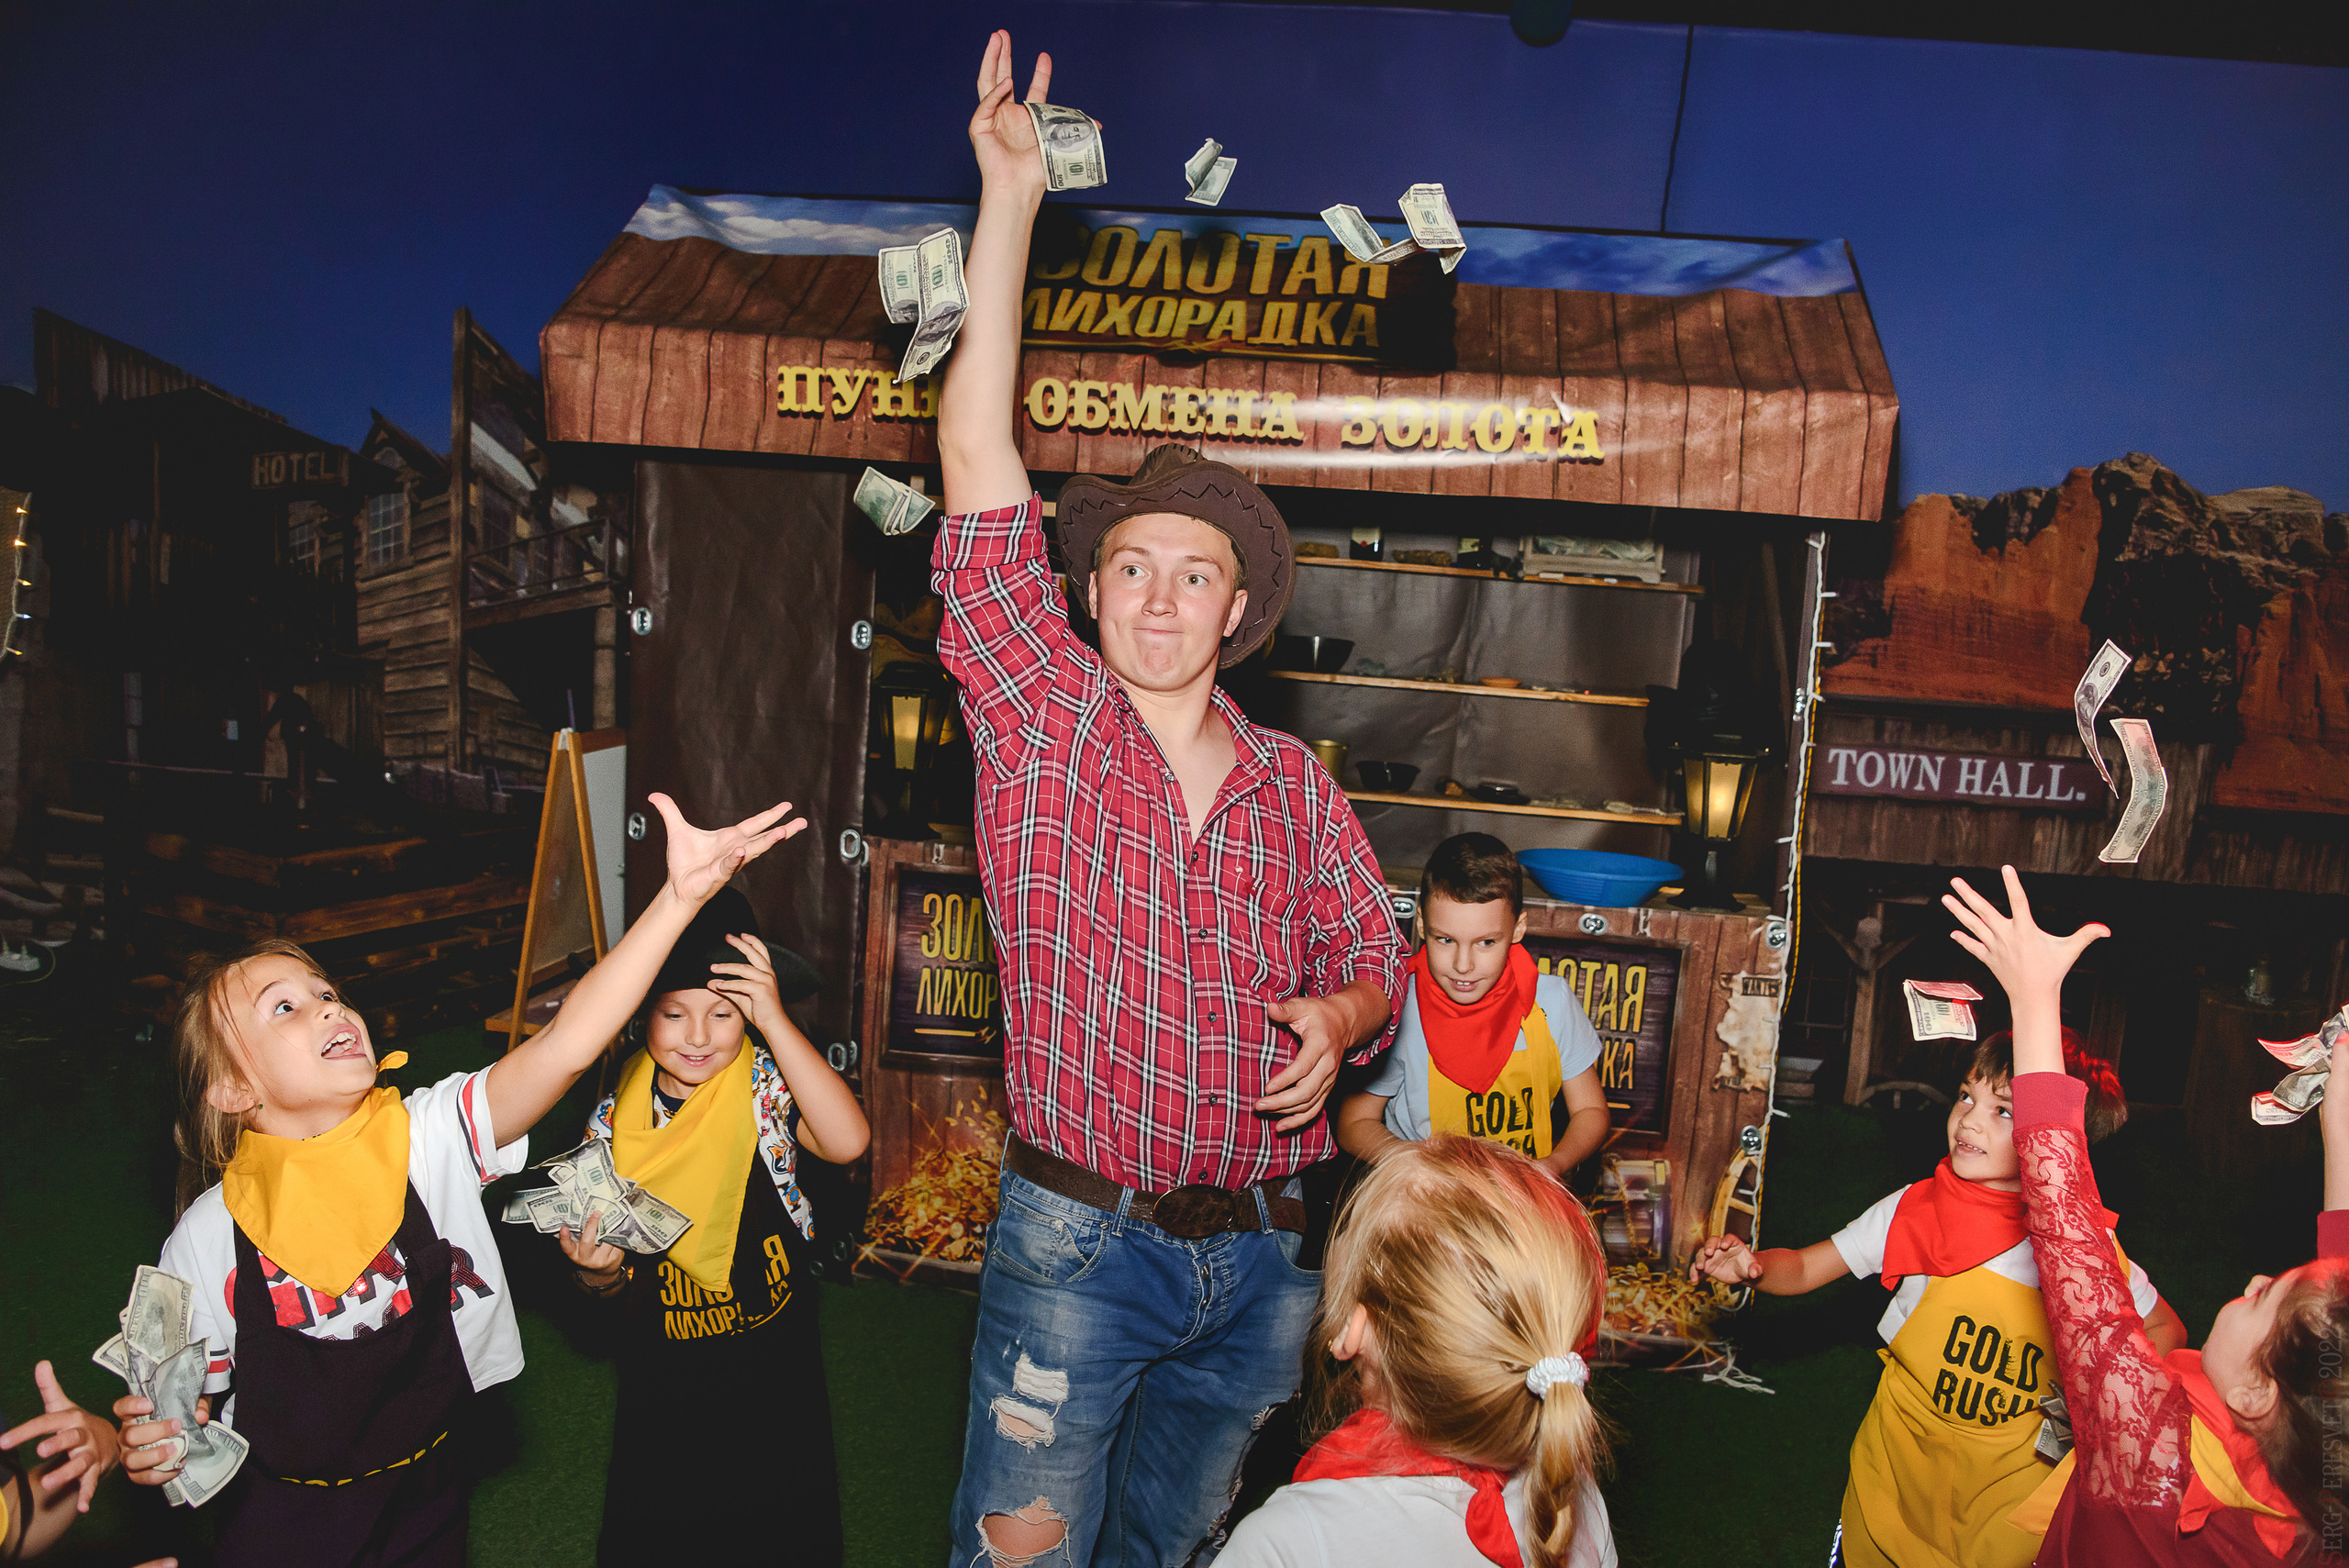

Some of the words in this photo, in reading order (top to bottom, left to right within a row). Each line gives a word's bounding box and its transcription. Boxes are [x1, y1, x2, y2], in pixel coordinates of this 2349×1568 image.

[1022, 287, 1379, 348] ЛИХОРАДКА
[1023, 377, 1305, 441] ОБМЕНА
[1341, 395, 1605, 460] ЗОЛОТА
[254, 450, 336, 486] HOTEL
[1828, 748, 1945, 792] TOWN
[1955, 757, 2087, 802] HALL.
[1943, 1315, 2044, 1393] GOLD
[1932, 1367, 2034, 1427] RUSH
